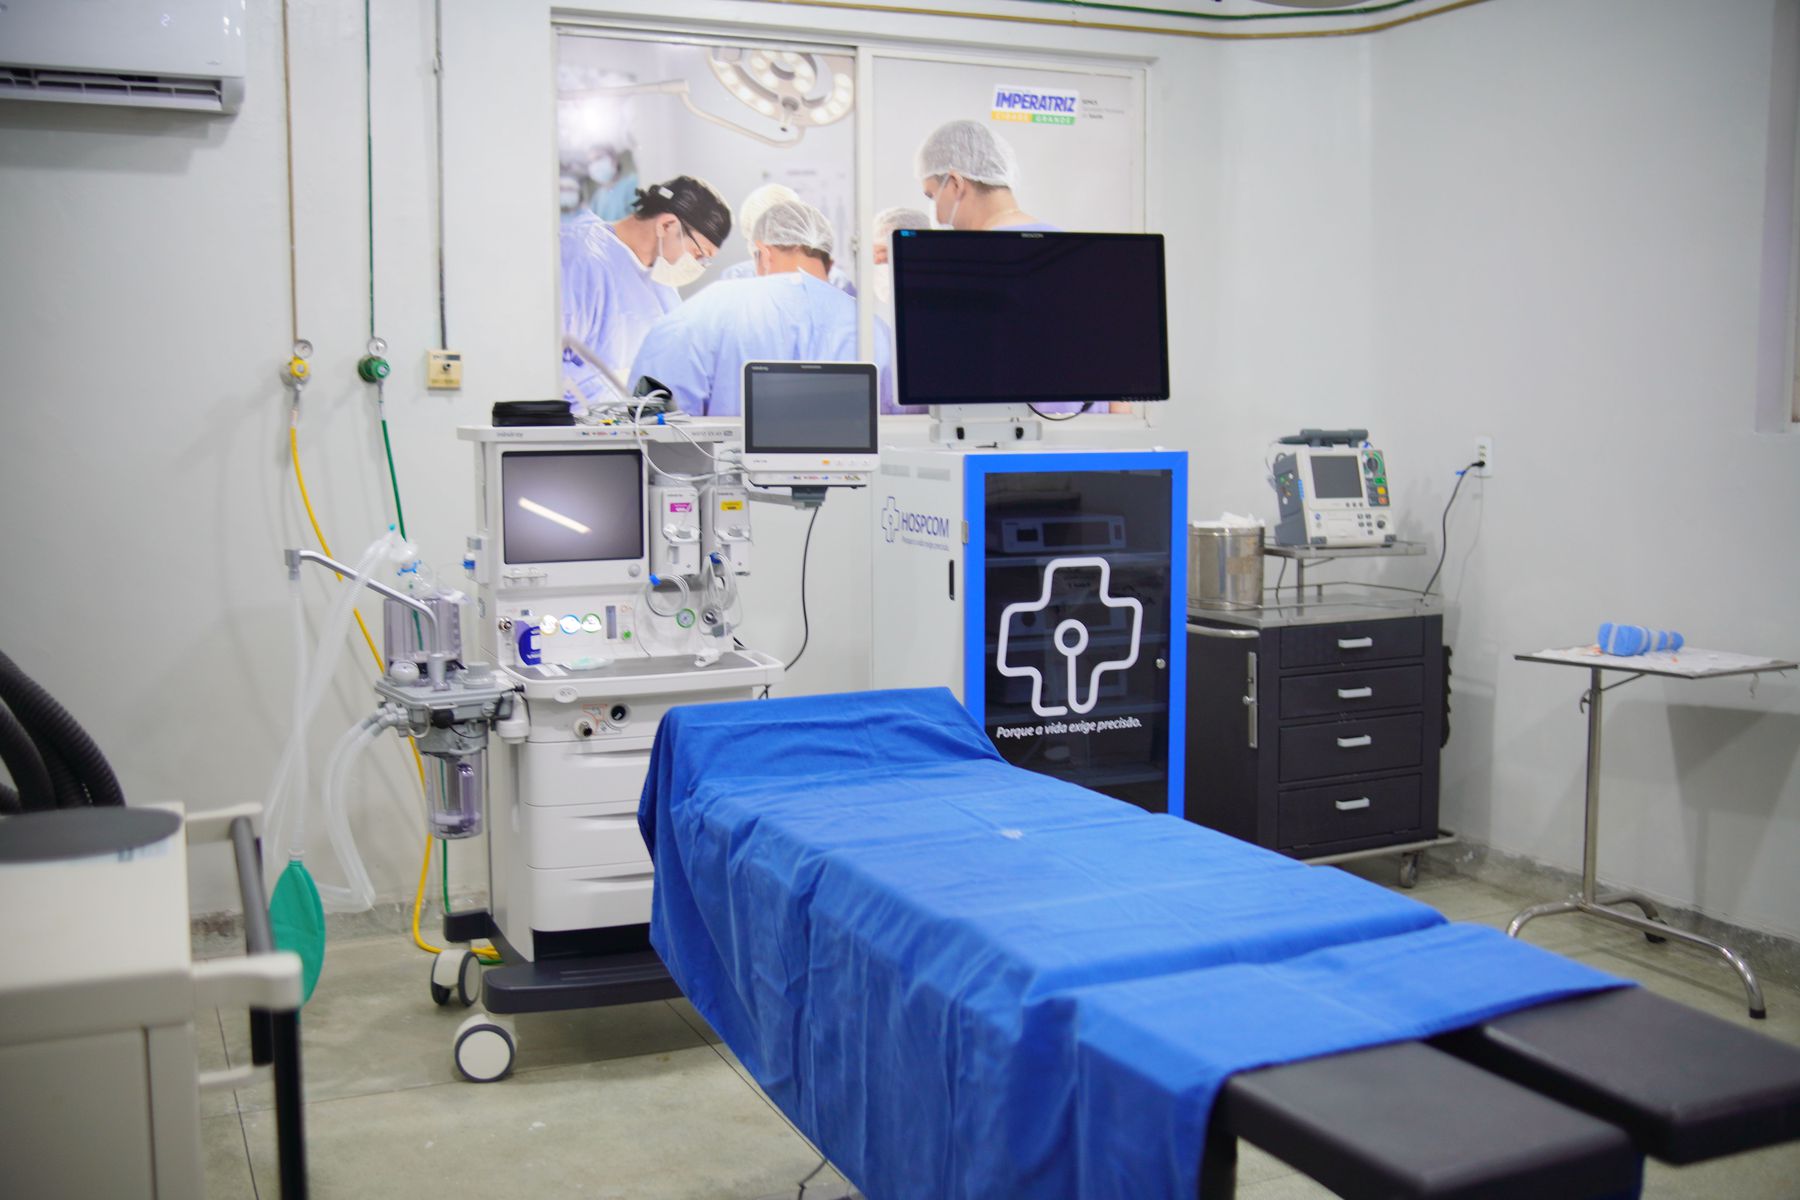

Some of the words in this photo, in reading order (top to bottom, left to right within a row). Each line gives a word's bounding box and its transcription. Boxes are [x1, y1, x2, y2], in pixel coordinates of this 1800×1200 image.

[995, 92, 1077, 113] IMPERATRIZ
[901, 511, 949, 538] HOSPCOM
[996, 726, 1034, 739] Porque
[1034, 726, 1043, 736] a
[1045, 721, 1068, 735] vida
[1068, 720, 1096, 735] exige
[1096, 716, 1142, 733] precisão.
